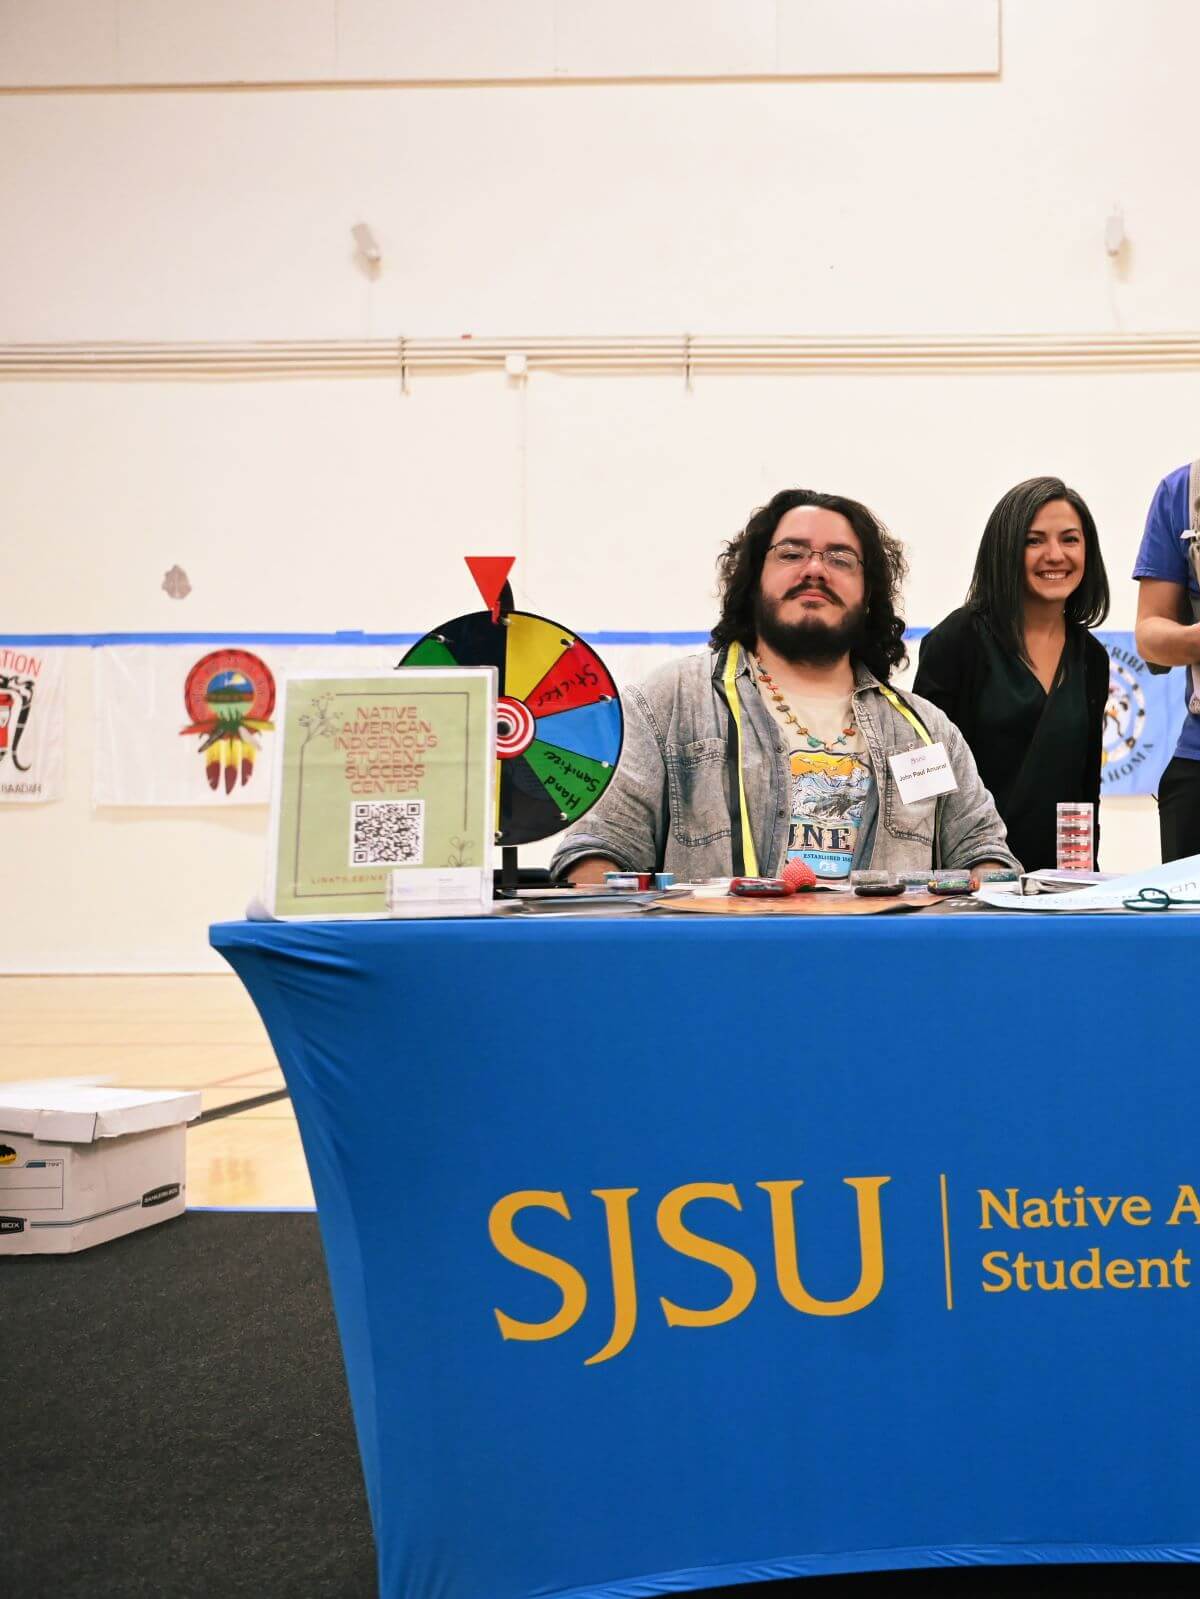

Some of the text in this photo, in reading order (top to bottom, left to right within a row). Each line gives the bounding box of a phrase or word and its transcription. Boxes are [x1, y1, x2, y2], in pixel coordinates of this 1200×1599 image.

[0, 650, 43, 678] TION
[356, 706, 417, 719] NATIVE
[343, 720, 431, 734] AMERICAN
[334, 735, 438, 749] INDIGENOUS
[345, 750, 426, 764] STUDENT
[345, 764, 425, 779] SUCCESS
[351, 780, 419, 794] CENTER
[543, 775, 582, 810] Hand
[979, 1186, 1151, 1229] Native
[489, 1177, 889, 1365] SJSU
[982, 1248, 1191, 1293] Student
